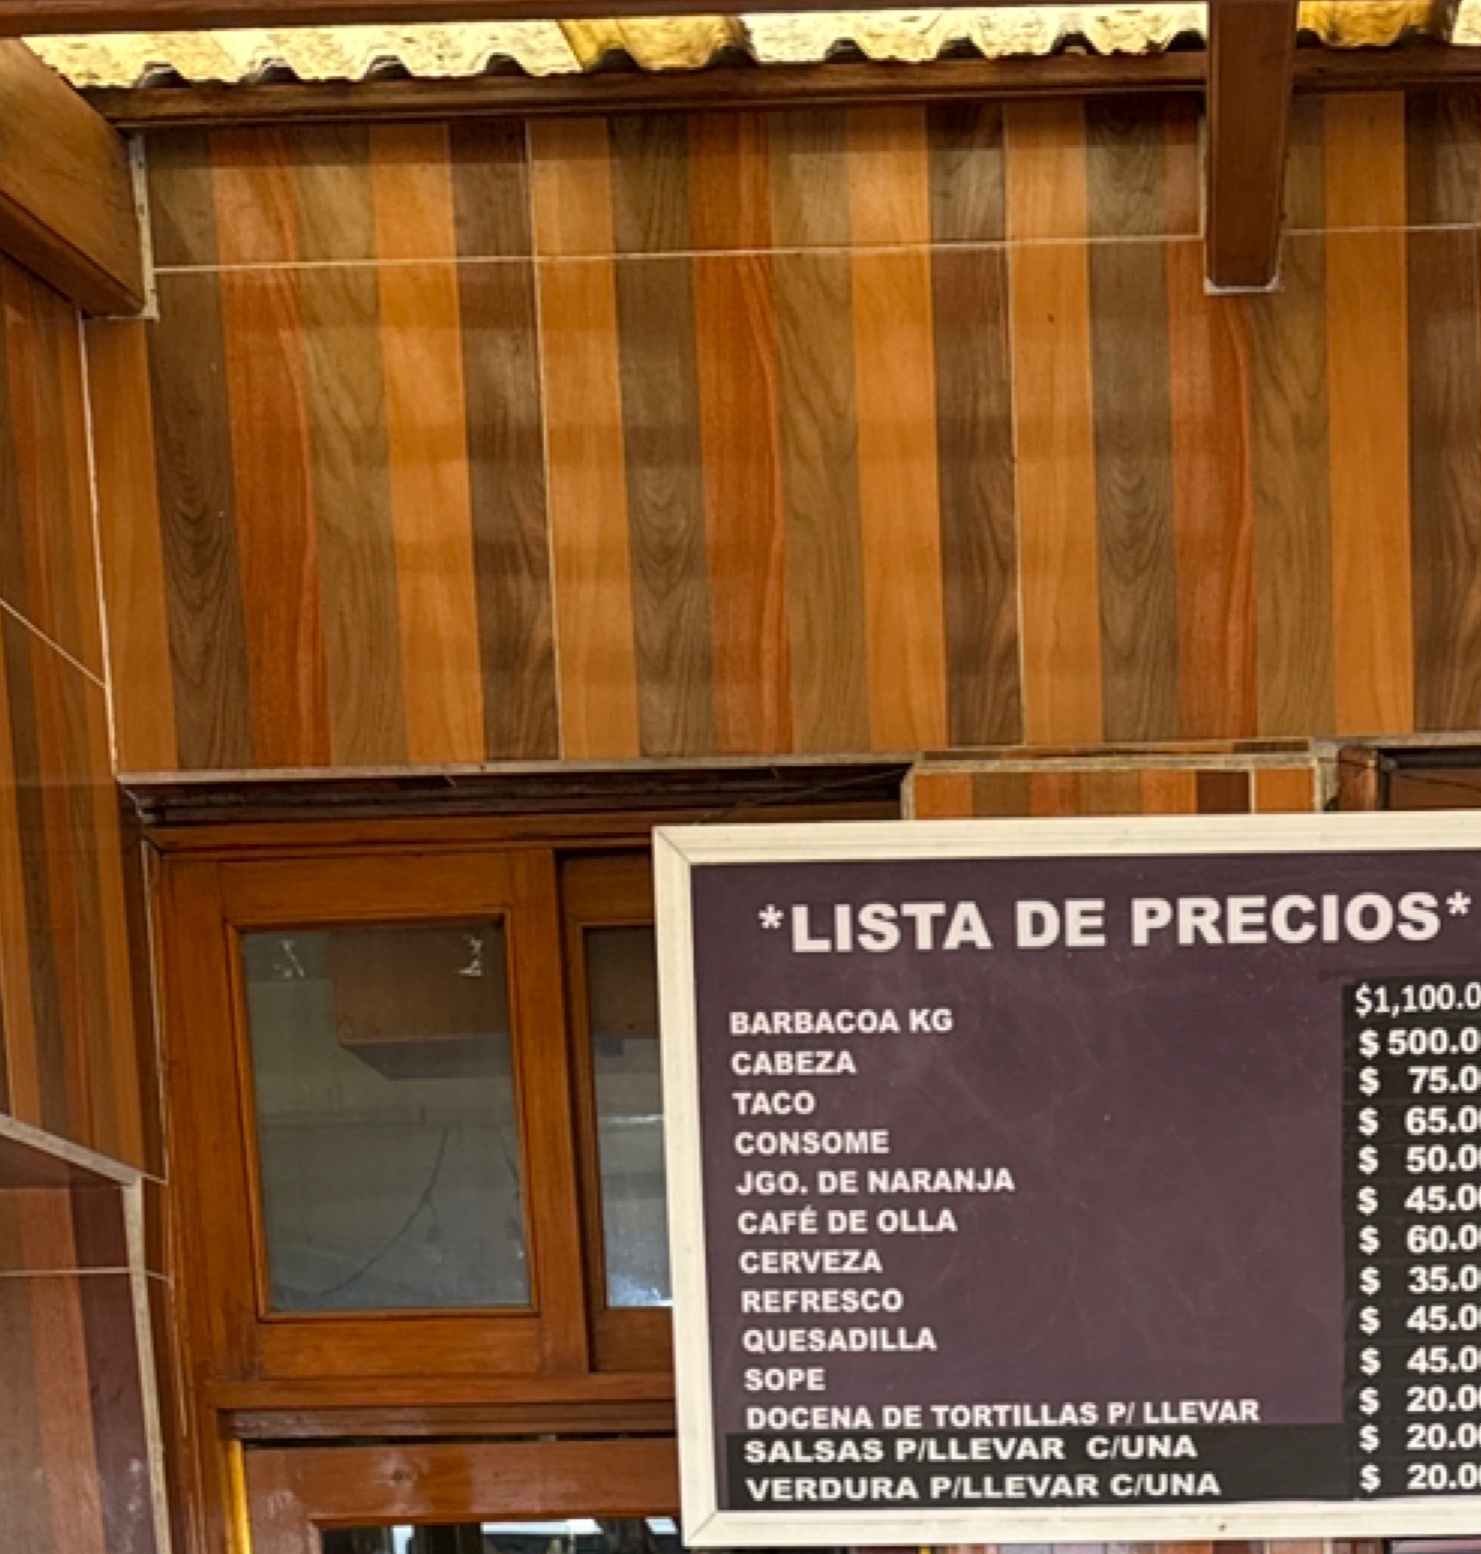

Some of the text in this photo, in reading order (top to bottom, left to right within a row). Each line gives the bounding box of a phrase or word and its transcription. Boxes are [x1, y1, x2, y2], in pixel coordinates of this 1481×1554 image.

[1016, 899, 1106, 948] DE
[730, 1008, 901, 1035] BARBACOA
[909, 1008, 953, 1032] KG
[731, 1050, 857, 1076] CABEZA
[1359, 1029, 1380, 1058] $
[732, 1090, 815, 1115] TACO
[1359, 1066, 1379, 1097] $
[734, 1130, 889, 1155] CONSOME
[1358, 1107, 1379, 1136] $
[735, 1170, 808, 1196] JGO.
[818, 1170, 859, 1193] DE
[867, 1167, 1015, 1193] NARANJA
[1358, 1146, 1379, 1175] $
[737, 1206, 818, 1235] CAFÉ
[827, 1209, 868, 1233] DE
[876, 1209, 958, 1233] OLLA
[1358, 1185, 1378, 1215] $
[739, 1249, 883, 1274] CERVEZA
[1359, 1225, 1380, 1255] $
[741, 1288, 904, 1313] REFRESCO
[1360, 1266, 1381, 1295] $
[743, 1326, 937, 1353] QUESADILLA
[1359, 1305, 1381, 1335] $
[744, 1368, 825, 1391] SOPE
[1360, 1347, 1381, 1376] $
[746, 1406, 874, 1430] DOCENA
[882, 1405, 922, 1429] DE
[930, 1402, 1099, 1428] TORTILLAS
[1107, 1401, 1135, 1425] P/
[1143, 1398, 1260, 1424] LLEVAR
[1359, 1386, 1379, 1415] $
[744, 1438, 884, 1463] SALSAS
[896, 1437, 1065, 1461] P/LLEVAR
[1086, 1434, 1198, 1460] C/UNA
[1359, 1425, 1379, 1453] $
[746, 1476, 919, 1502] VERDURA
[930, 1474, 1099, 1499] P/LLEVAR
[1110, 1473, 1220, 1496] C/UNA
[1360, 1464, 1381, 1493] $
